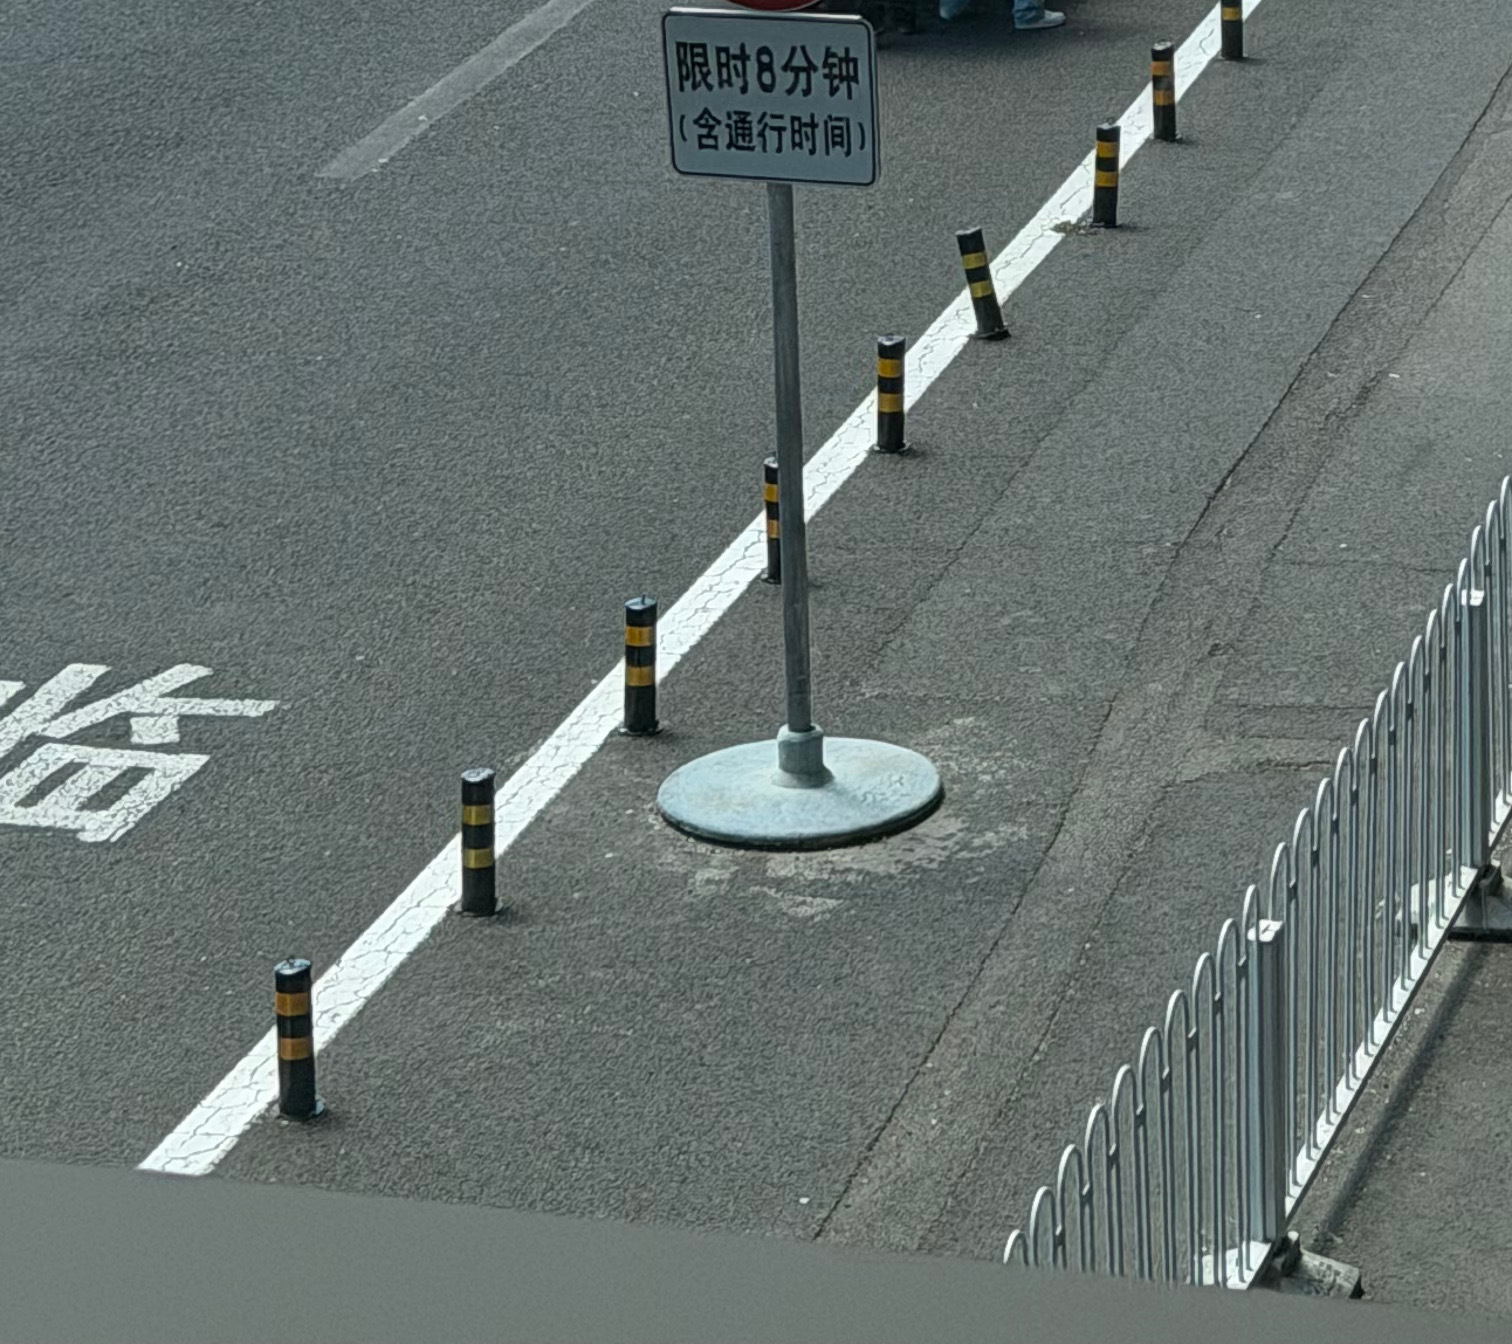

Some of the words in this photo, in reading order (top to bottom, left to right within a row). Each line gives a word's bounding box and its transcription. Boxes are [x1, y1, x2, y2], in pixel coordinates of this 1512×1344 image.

[674, 40, 861, 101] 限时8分钟
[678, 107, 866, 158] (含通行时间)
